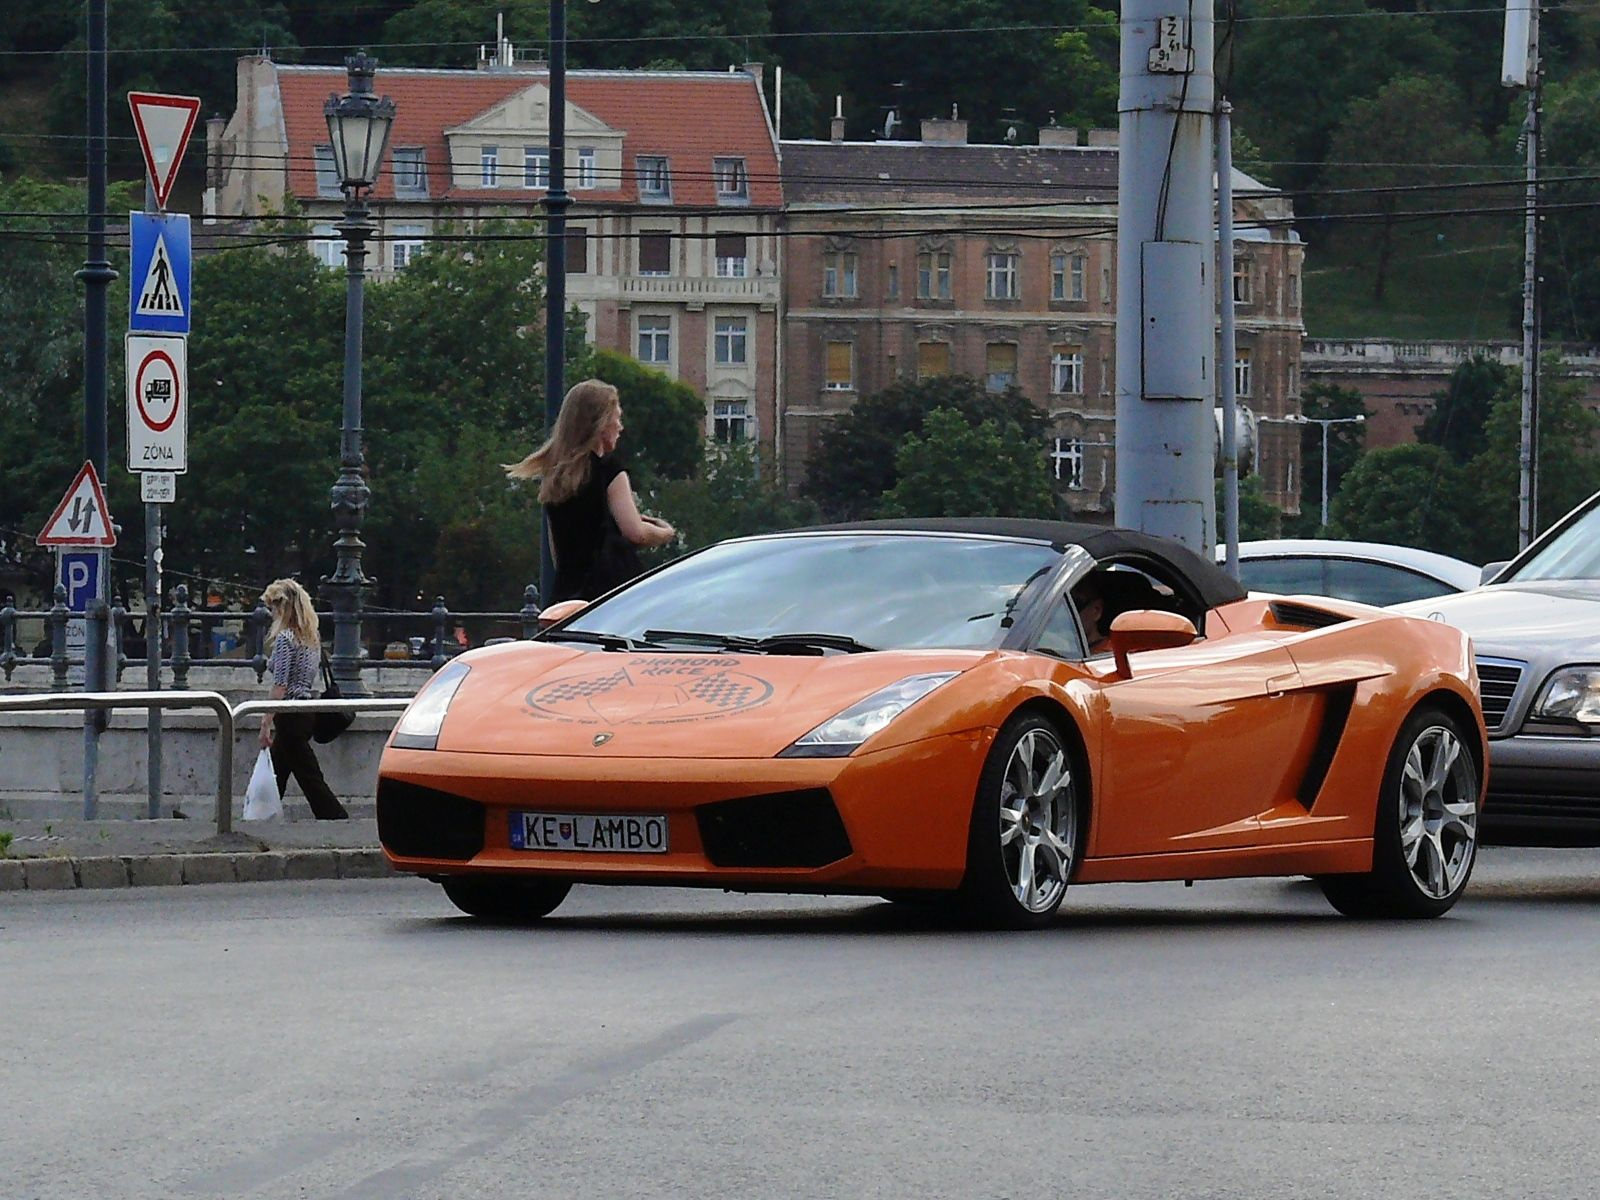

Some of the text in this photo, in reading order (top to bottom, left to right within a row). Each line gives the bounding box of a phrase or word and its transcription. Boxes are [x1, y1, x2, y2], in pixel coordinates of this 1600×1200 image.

[1167, 23, 1177, 36] Z
[142, 441, 174, 460] ZÓNA
[69, 561, 89, 608] P
[628, 657, 741, 668] DIAMOND
[640, 667, 704, 677] RACE
[525, 815, 663, 849] KE LAMBO
